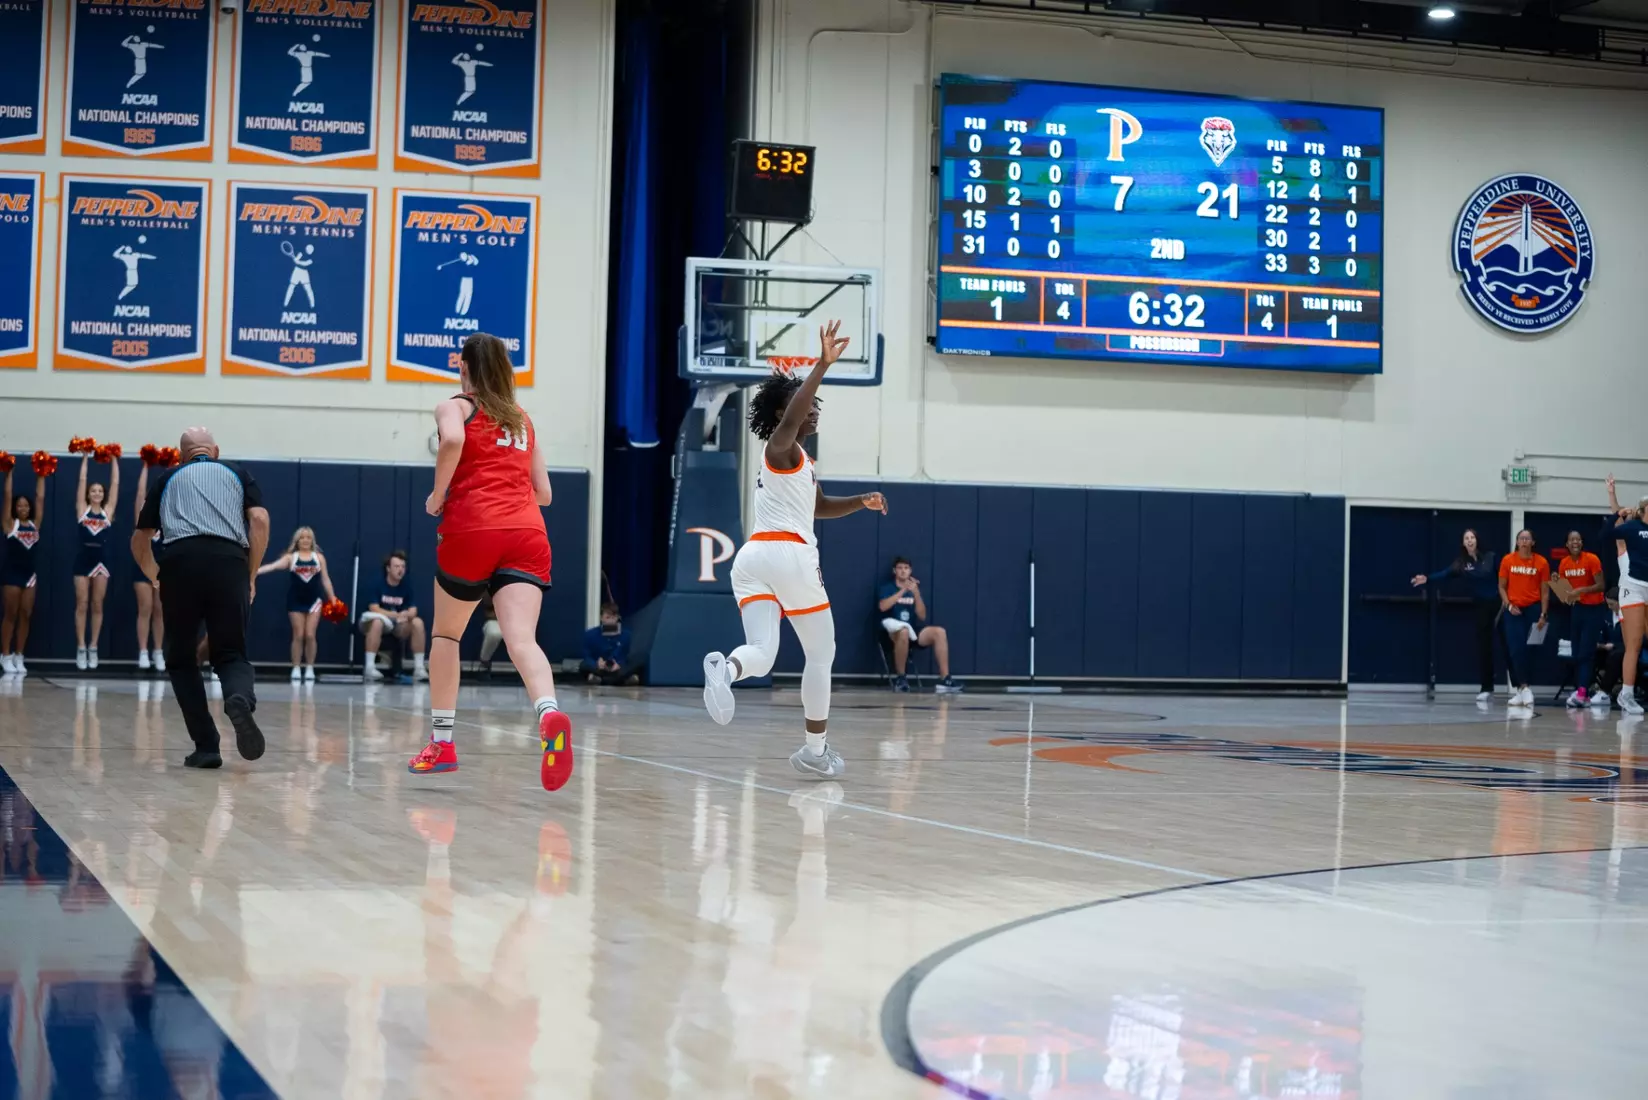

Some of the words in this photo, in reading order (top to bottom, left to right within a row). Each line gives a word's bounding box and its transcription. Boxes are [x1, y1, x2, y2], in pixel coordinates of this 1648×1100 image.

[90, 8, 123, 16] MEN'S
[130, 10, 198, 19] VOLLEYBALL
[246, 0, 372, 19] PEPPERDINE
[412, 0, 533, 28] PEPPERDINE
[256, 16, 289, 24] MEN'S
[296, 18, 363, 28] VOLLEYBALL
[420, 25, 453, 34] MEN'S
[460, 28, 524, 38] VOLLEYBALL
[121, 93, 158, 106] NCAA
[288, 102, 324, 114] NCAA
[78, 109, 132, 124] NATIONAL
[135, 110, 199, 126] CHAMPIONS
[246, 116, 298, 131] NATIONAL
[302, 120, 365, 134] CHAMPIONS
[452, 110, 488, 123] NCAA
[124, 128, 156, 144] 1985
[410, 125, 462, 140] NATIONAL
[466, 128, 527, 144] CHAMPIONS
[964, 117, 986, 130] PLR
[1004, 120, 1028, 133] PTS
[1046, 122, 1066, 136] FLS
[1096, 108, 1143, 162] P
[290, 136, 322, 152] 1986
[455, 144, 486, 160] 1992
[969, 134, 982, 152] 0
[1008, 137, 1022, 156] 2
[1050, 140, 1062, 158] 0
[1266, 140, 1288, 152] PLR
[1304, 142, 1325, 156] PTS
[1342, 145, 1361, 158] FLS
[757, 148, 807, 174] 6:32
[1272, 156, 1283, 174] 5
[1310, 159, 1321, 177] 8
[1346, 162, 1357, 180] 0
[968, 159, 981, 178] 3
[1008, 162, 1021, 180] 0
[1049, 165, 1062, 183] 0
[963, 184, 986, 203] 10
[1008, 187, 1021, 206] 2
[1048, 190, 1061, 208] 0
[1110, 175, 1134, 212] 7
[1196, 182, 1240, 219] 21
[1266, 180, 1288, 199] 12
[1309, 183, 1321, 201] 4
[1348, 186, 1357, 204] 1
[72, 190, 200, 219] PEPPERDINE
[239, 196, 364, 226] PEPPERDINE
[81, 218, 115, 226] MEN'S
[121, 220, 190, 229] VOLLEYBALL
[404, 204, 527, 234] PEPPERDINE
[962, 210, 986, 229] 15
[1010, 212, 1020, 231] 1
[1050, 214, 1060, 233] 1
[1265, 204, 1288, 224] 22
[1309, 208, 1321, 226] 2
[1346, 210, 1357, 228] 0
[1460, 178, 1520, 249] PEPPERDINE
[1536, 180, 1591, 260] UNIVERSITY
[252, 224, 296, 235] MEN'S
[304, 226, 355, 238] TENNIS
[418, 232, 467, 244] MEN'S
[476, 235, 517, 247] GOLF
[1265, 229, 1288, 248] 30
[1309, 232, 1320, 250] 2
[1348, 234, 1356, 252] 1
[962, 234, 985, 254] 31
[1007, 237, 1020, 256] 0
[1048, 240, 1060, 258] 0
[1150, 238, 1185, 260] 2ND
[1265, 253, 1287, 272] 33
[1309, 256, 1320, 274] 3
[1346, 258, 1357, 276] 0
[960, 278, 990, 292] TEAM
[992, 279, 1026, 293] FOULS
[1054, 282, 1075, 296] TOL
[990, 296, 1003, 321] 1
[1057, 300, 1070, 320] 4
[1128, 290, 1205, 327] 6:32
[1256, 294, 1275, 308] TOL
[1302, 296, 1329, 311] TEAM
[1332, 298, 1362, 313] FOULS
[1476, 292, 1495, 312] FREELY
[1503, 314, 1534, 325] RECEIVED
[1539, 311, 1560, 324] FREELY
[1560, 299, 1574, 314] GIVE
[114, 305, 150, 318] NCAA
[280, 312, 317, 325] NCAA
[71, 320, 124, 336] NATIONAL
[127, 322, 192, 338] CHAMPIONS
[444, 318, 479, 330] NCAA
[1261, 312, 1274, 331] 4
[1326, 314, 1338, 338] 1
[239, 328, 291, 342] NATIONAL
[294, 330, 357, 345] CHAMPIONS
[404, 333, 456, 348] NATIONAL
[112, 340, 148, 356] 2005
[280, 347, 316, 364] 2006
[942, 348, 991, 356] DAKTRONICS
[496, 424, 528, 451] 30
[1512, 468, 1528, 483] EXIT
[686, 527, 735, 581] P
